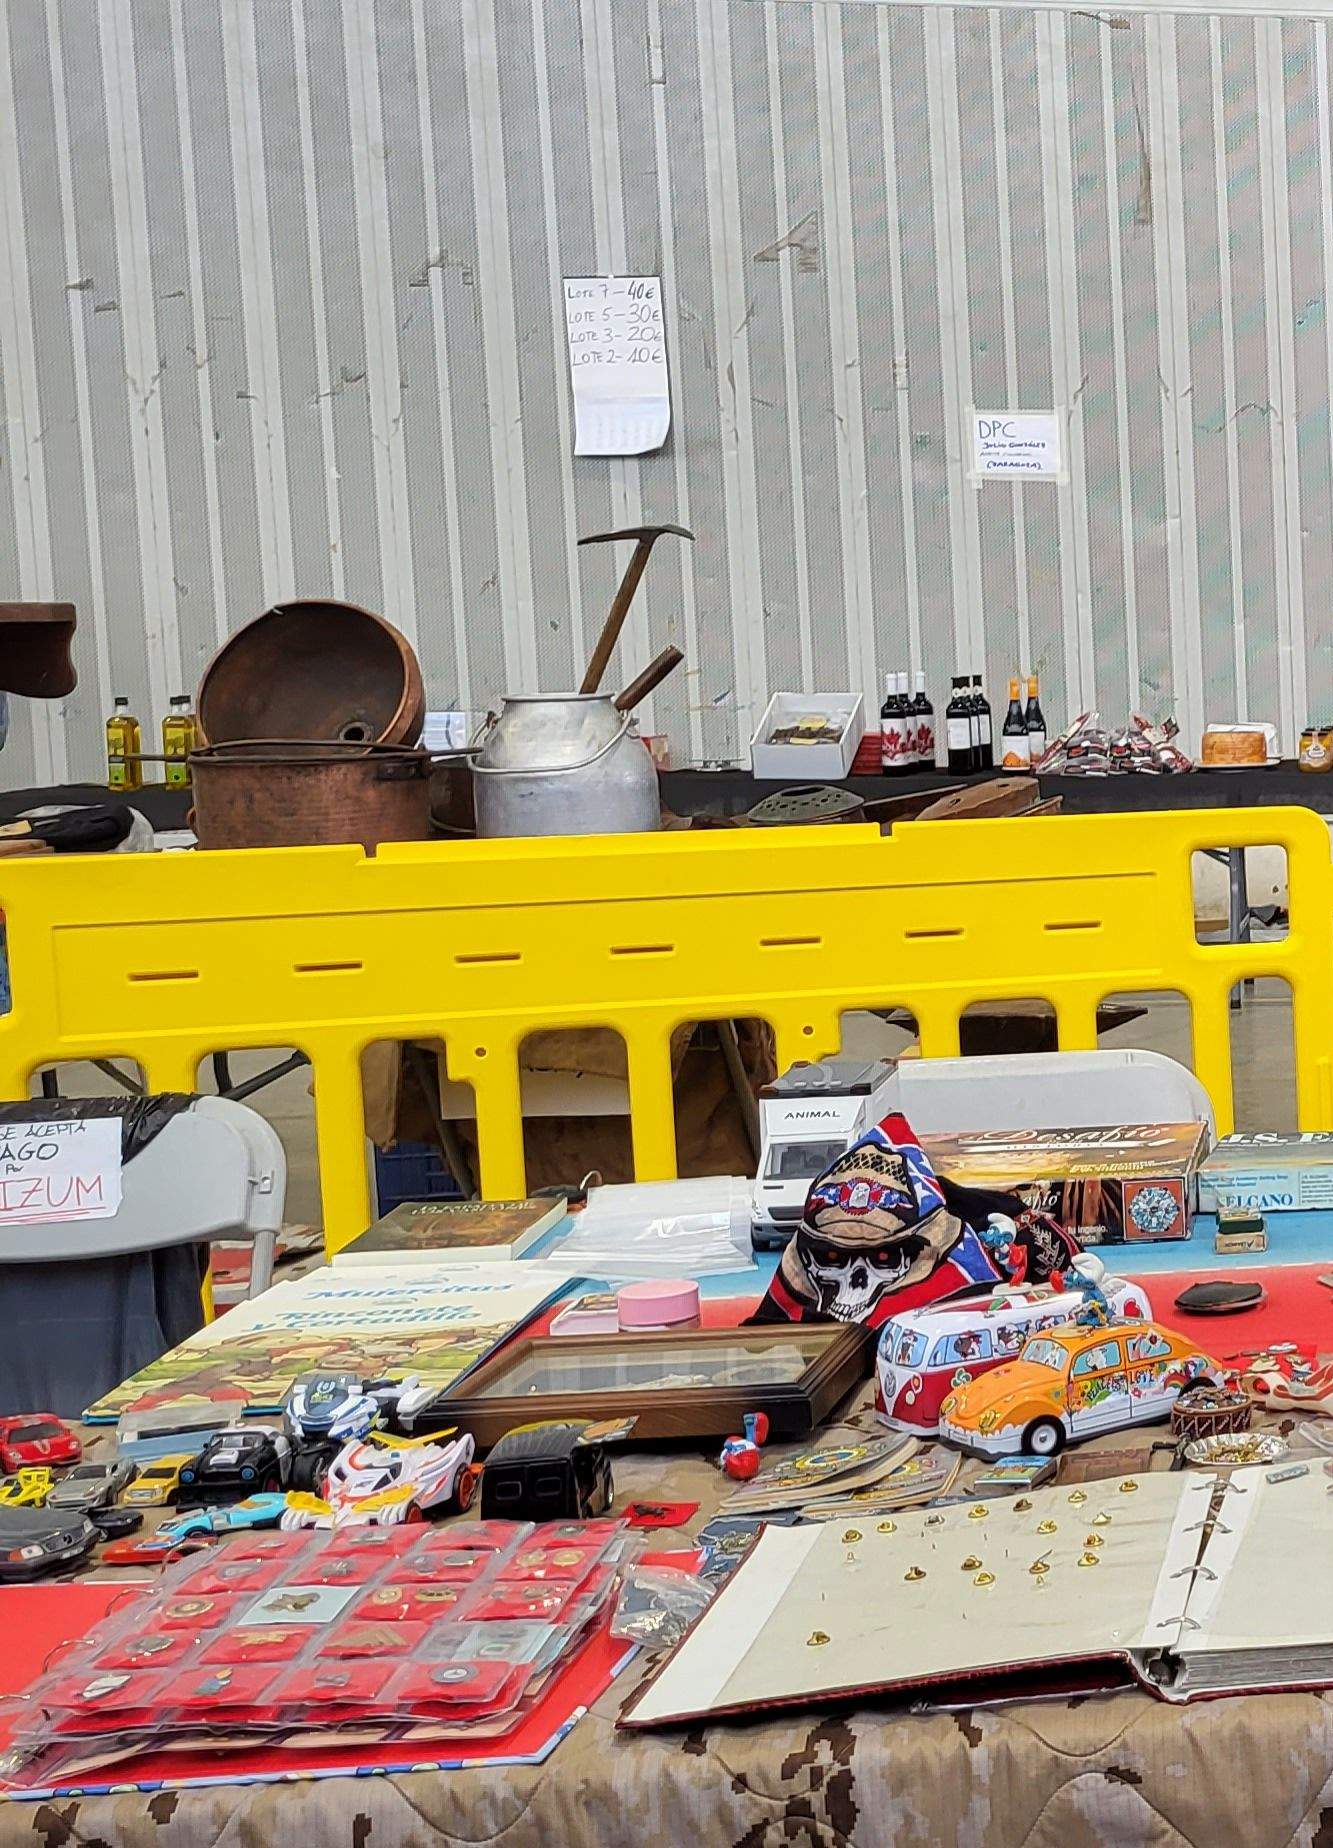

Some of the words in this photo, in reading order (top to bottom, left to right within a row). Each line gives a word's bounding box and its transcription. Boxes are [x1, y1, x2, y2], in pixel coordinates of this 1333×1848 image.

[569, 311, 595, 324] LOTE
[570, 331, 598, 343] LOTE
[573, 351, 603, 366] LOTE
[978, 419, 1016, 439] DPC
[784, 1110, 841, 1120] ANIMAL
[25, 1120, 87, 1138] ACEPTA
[0, 1142, 59, 1161] AGO
[304, 1283, 515, 1300] Mujercitas
[276, 1304, 474, 1321] Rinconete
[285, 1311, 483, 1329] Cortadillo
[1129, 1368, 1155, 1385] LOVE
